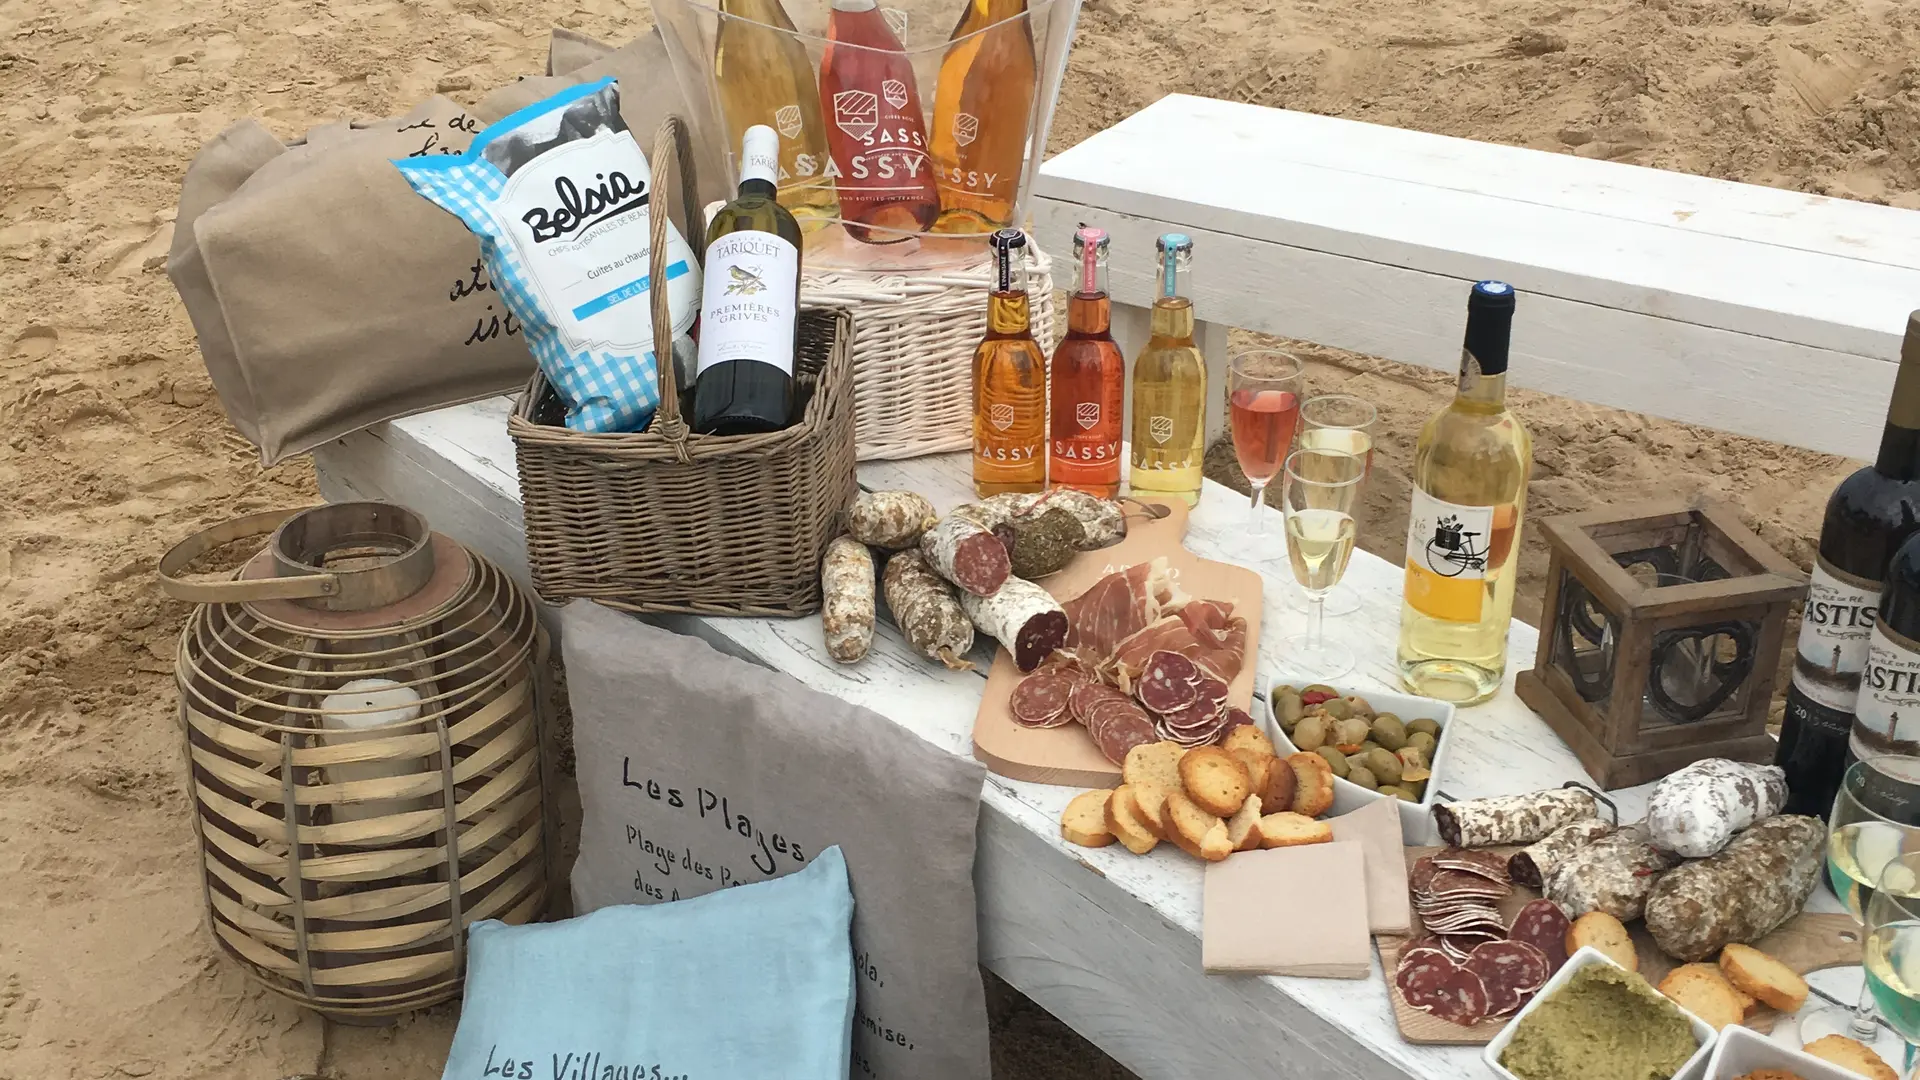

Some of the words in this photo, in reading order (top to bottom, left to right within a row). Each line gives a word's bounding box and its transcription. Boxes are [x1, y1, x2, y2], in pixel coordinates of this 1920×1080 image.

[448, 113, 481, 134] de
[796, 153, 925, 180] SASSY
[936, 163, 998, 189] ASSY
[521, 171, 646, 244] Belsia
[547, 244, 571, 257] CHIPS
[571, 222, 618, 253] ARTISANALES
[617, 215, 629, 228] DE
[716, 240, 781, 260] TARIQUET
[586, 262, 614, 280] Cuites
[614, 258, 625, 269] au
[710, 302, 780, 320] PREMIÈRES
[719, 312, 768, 324] GRIVES
[1055, 440, 1118, 461] SASSY
[1862, 662, 1920, 694] ASTI
[623, 756, 684, 808] Les
[626, 824, 676, 876] Plage
[682, 848, 714, 880] des
[634, 869, 664, 900] des
[483, 1044, 534, 1080] Les
